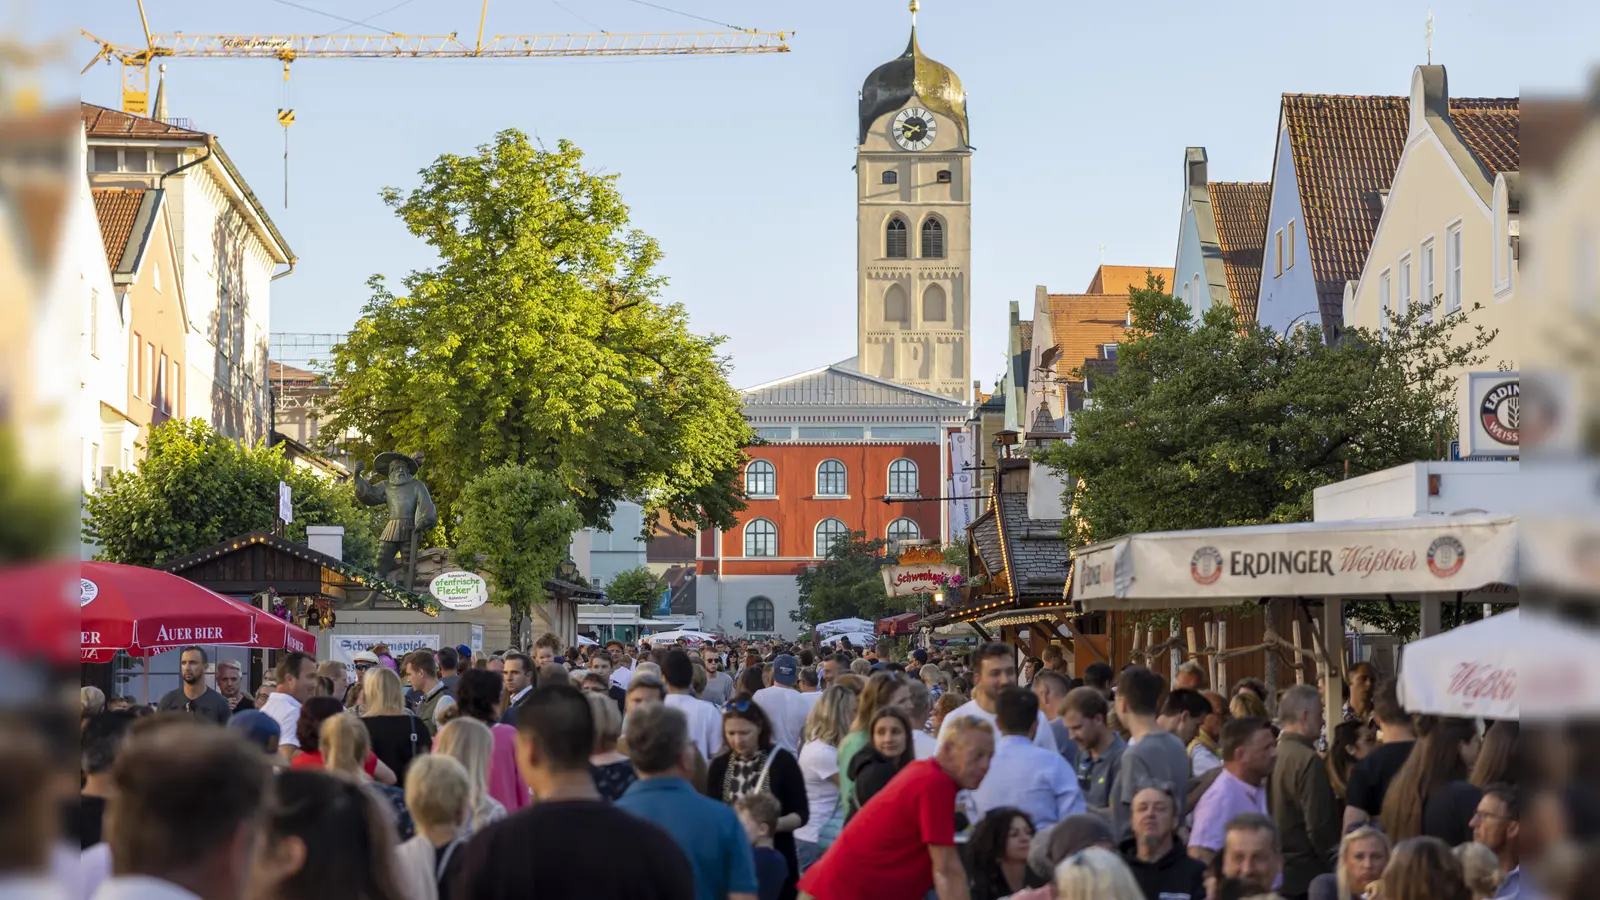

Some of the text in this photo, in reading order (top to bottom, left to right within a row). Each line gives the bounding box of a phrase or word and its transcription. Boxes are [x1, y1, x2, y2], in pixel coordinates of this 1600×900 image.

[1489, 421, 1518, 441] WEISS
[1230, 550, 1335, 578] ERDINGER
[1339, 545, 1418, 579] Weißbier
[435, 577, 480, 586] ofenfrische
[156, 624, 223, 641] AUER BIER
